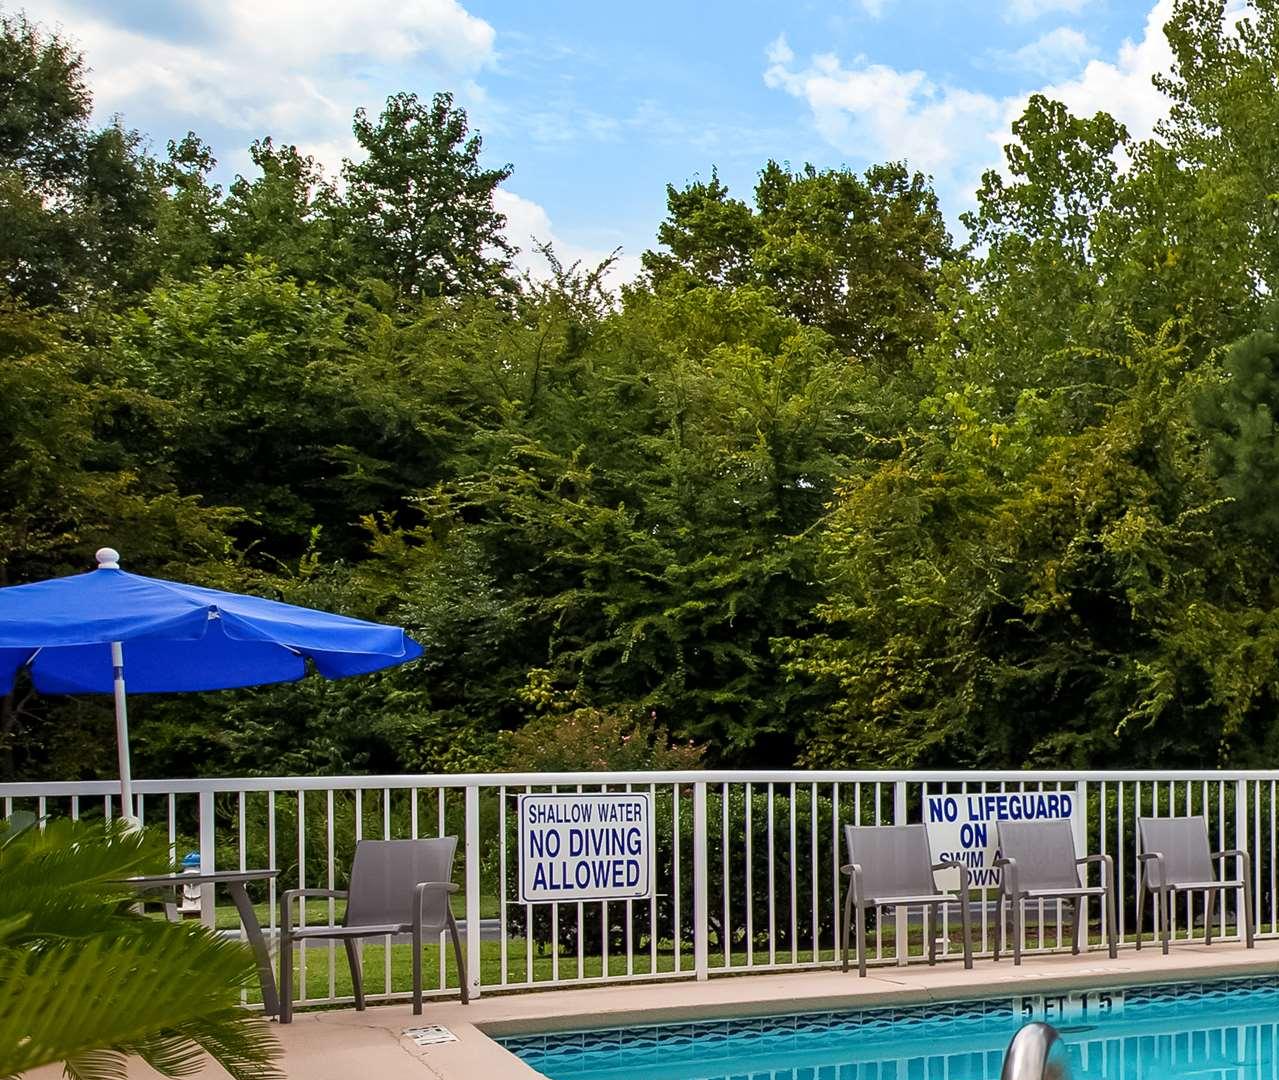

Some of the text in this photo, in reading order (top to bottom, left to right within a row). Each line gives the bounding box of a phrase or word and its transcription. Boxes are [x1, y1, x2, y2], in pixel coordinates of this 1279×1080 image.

[528, 803, 642, 824] SHALLOW WATER
[929, 794, 1072, 822] NO LIFEGUARD
[530, 827, 641, 858] NO DIVING
[960, 823, 987, 848] ON
[532, 859, 640, 891] ALLOWED
[1044, 995, 1067, 1013] FT
